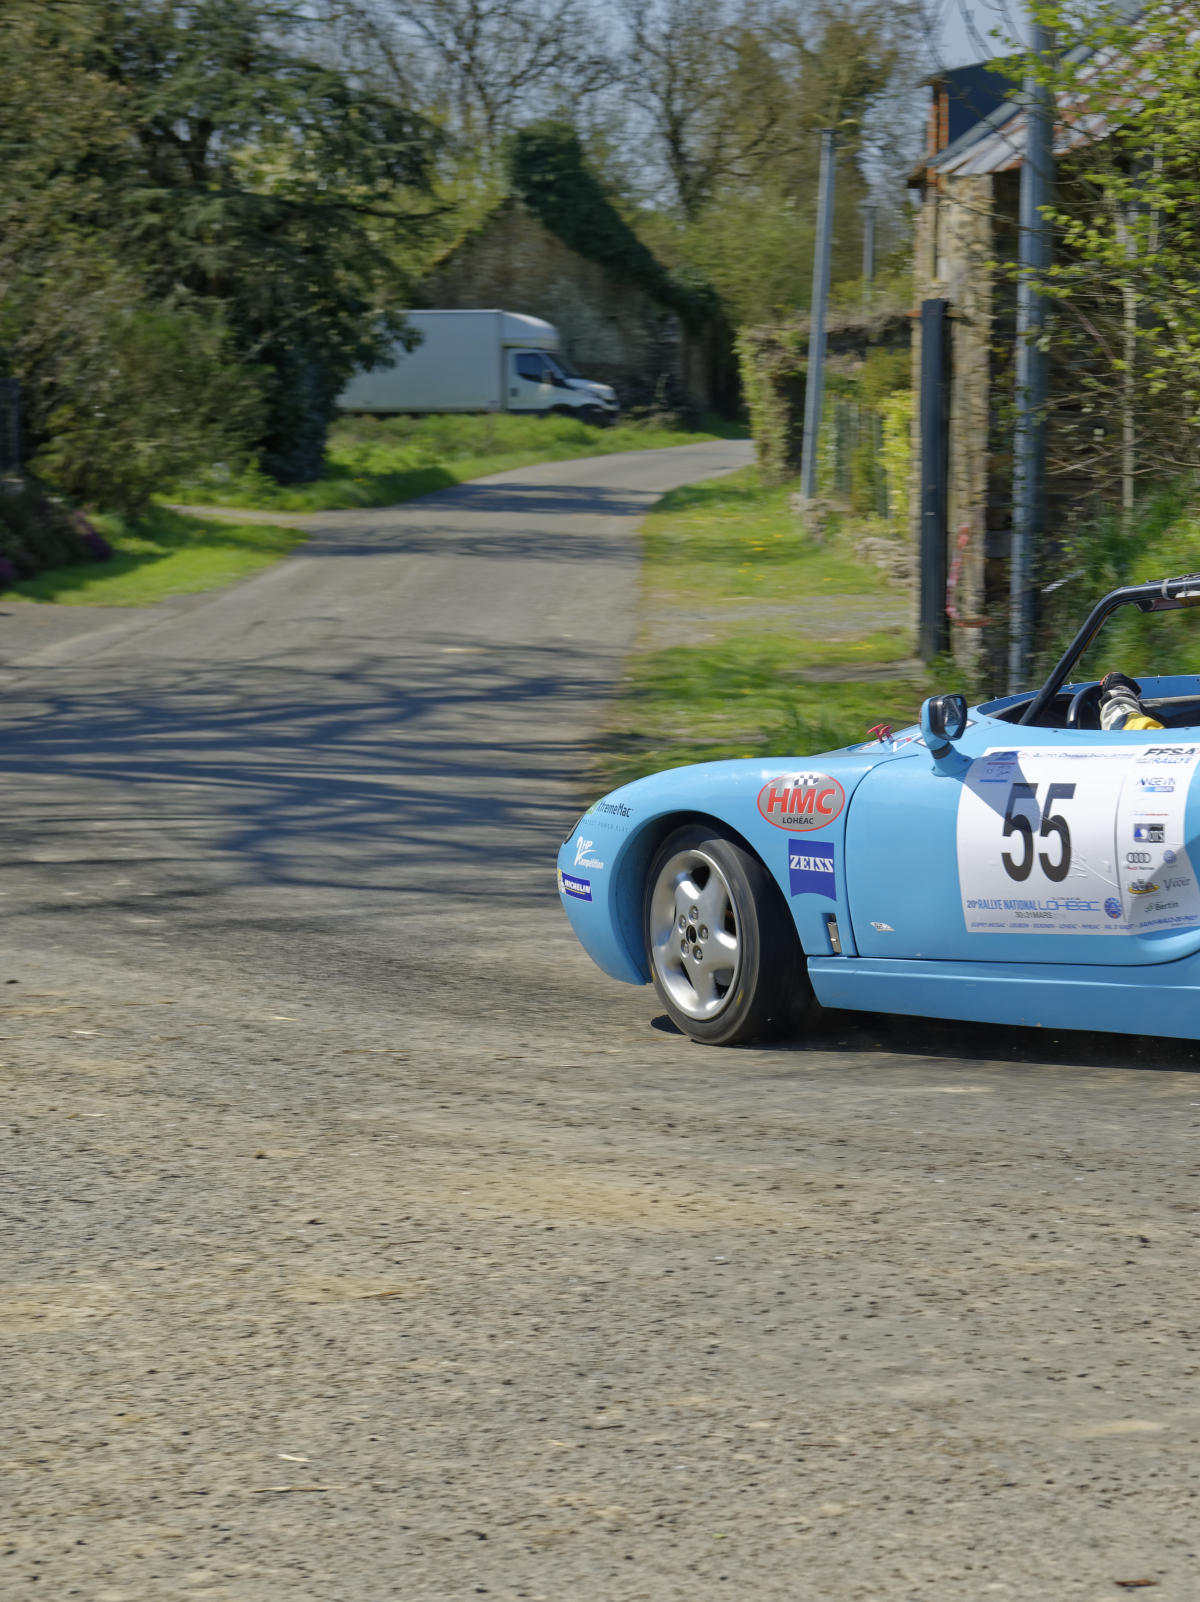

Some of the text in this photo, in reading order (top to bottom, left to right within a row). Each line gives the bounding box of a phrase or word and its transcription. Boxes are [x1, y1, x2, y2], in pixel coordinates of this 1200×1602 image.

[767, 788, 836, 815] HMC
[1001, 783, 1077, 882] 55
[790, 855, 834, 873] ZEISS
